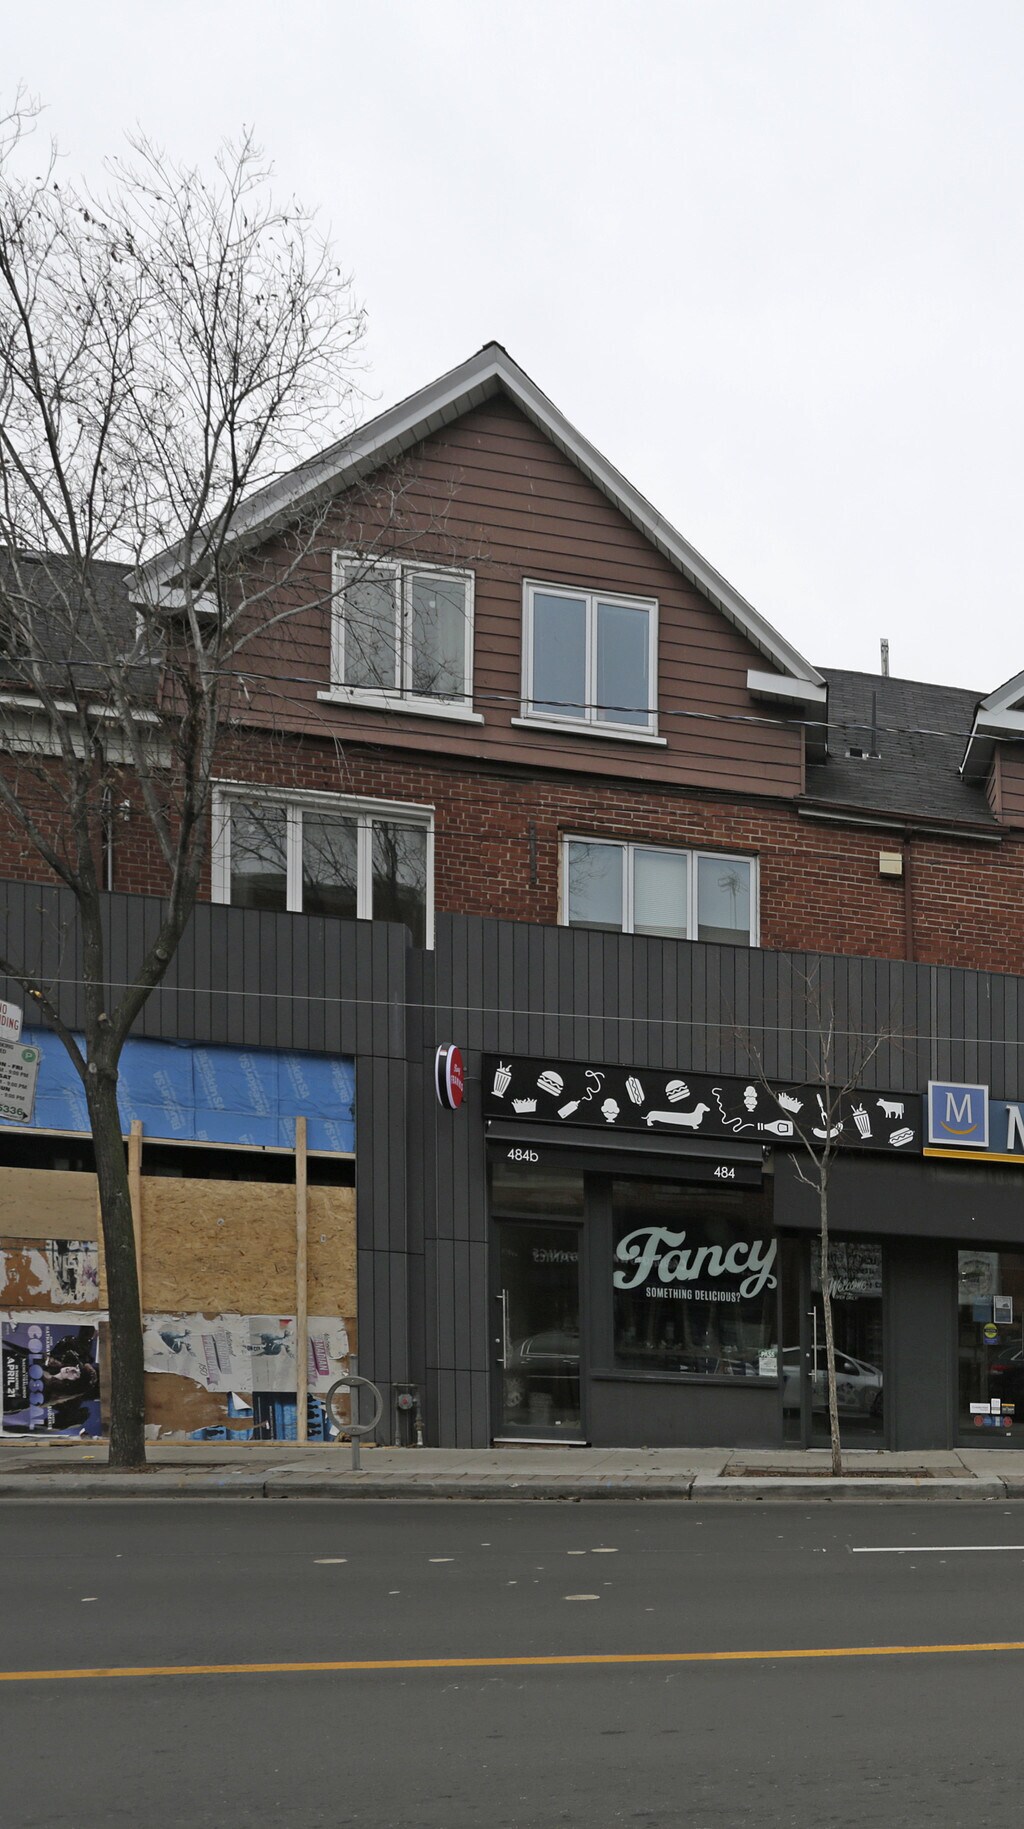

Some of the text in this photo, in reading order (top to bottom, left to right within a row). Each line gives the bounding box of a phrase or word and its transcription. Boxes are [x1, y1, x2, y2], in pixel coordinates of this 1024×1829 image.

[945, 1092, 972, 1123] M
[507, 1148, 539, 1162] 484b
[714, 1166, 735, 1178] 484
[613, 1226, 778, 1299] Fancy
[645, 1286, 741, 1303] SOMETHING DELICIOUS?
[7, 1356, 15, 1398] APRIL 21
[28, 1324, 44, 1430] COLOSSAL
